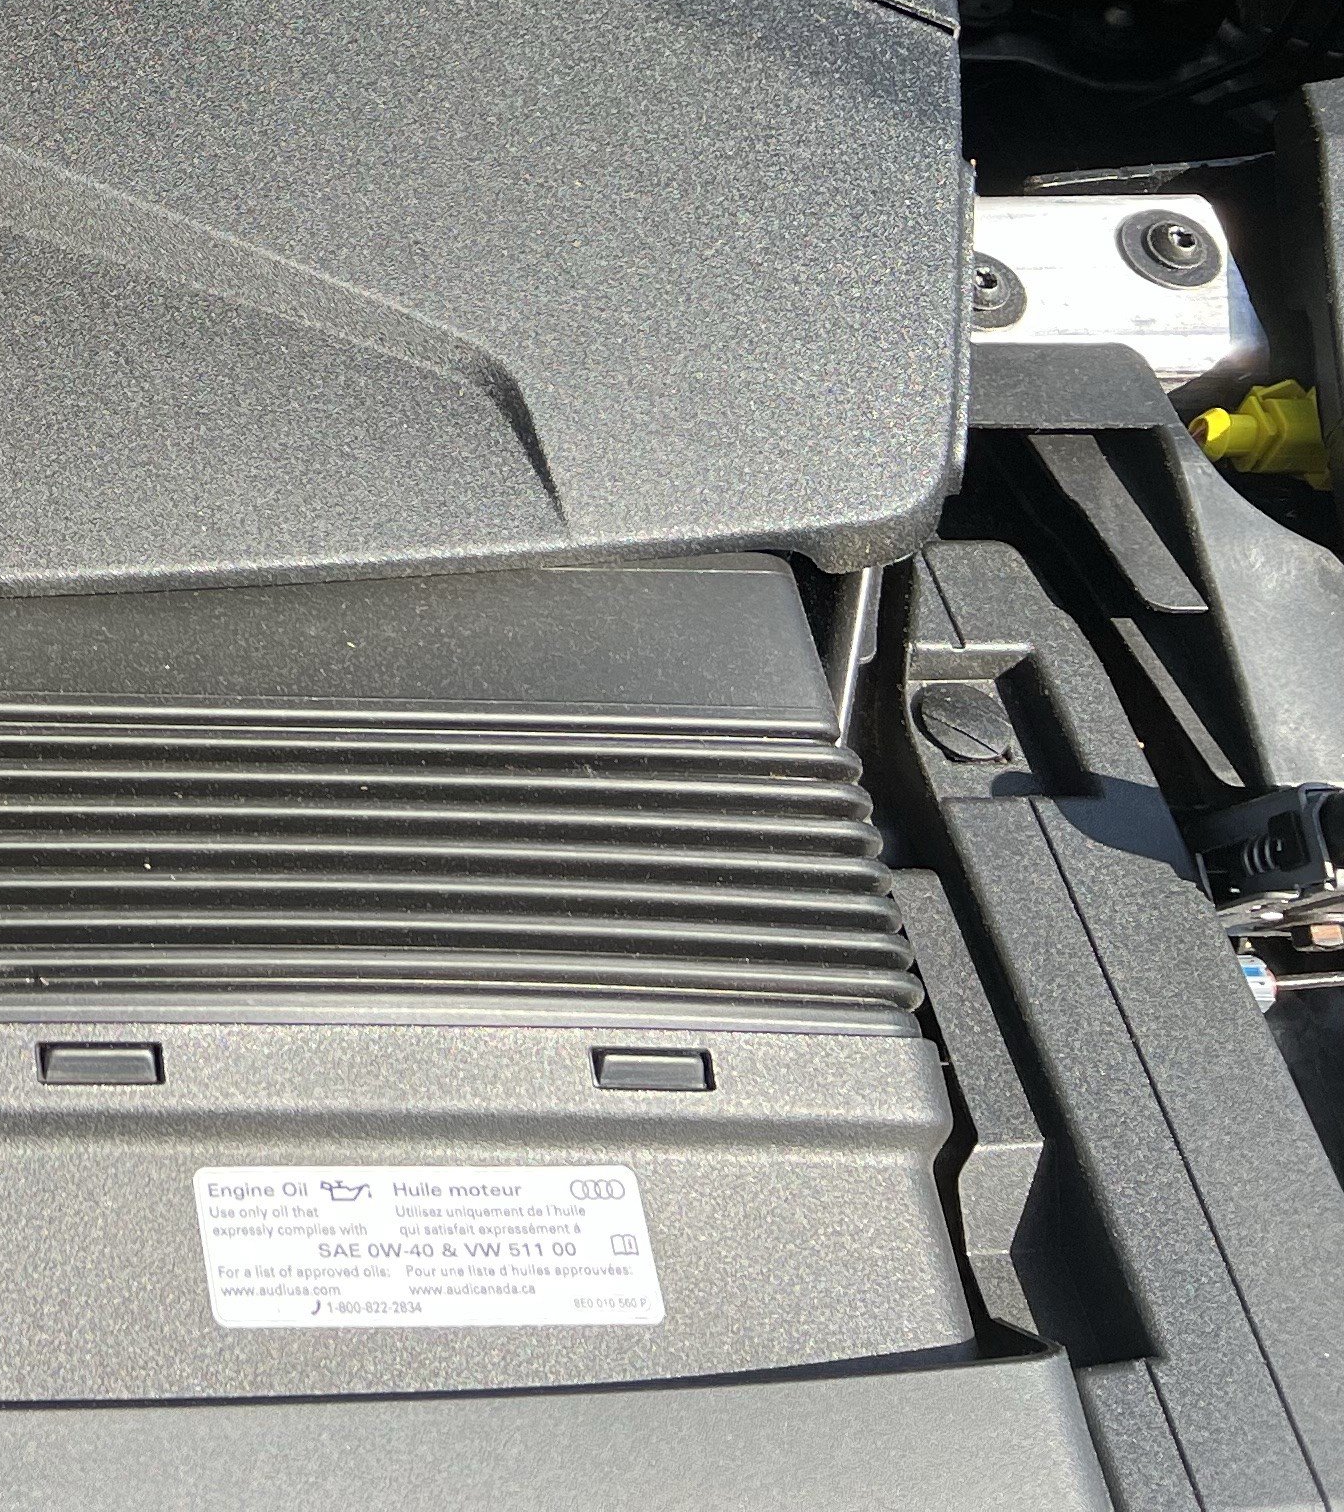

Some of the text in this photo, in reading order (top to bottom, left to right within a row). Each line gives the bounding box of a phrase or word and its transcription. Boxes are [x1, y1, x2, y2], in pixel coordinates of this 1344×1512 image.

[207, 1181, 308, 1200] Engine Oil
[392, 1181, 522, 1197] Huile moteur
[209, 1206, 319, 1221] Use only oil that
[395, 1205, 442, 1218] Utilisez
[446, 1205, 524, 1220] uniquement
[527, 1205, 543, 1217] de
[212, 1223, 368, 1238] expressly complies with
[399, 1223, 420, 1237] qui
[424, 1222, 475, 1235] satisfait
[479, 1222, 569, 1237] expressément
[318, 1242, 577, 1258] SAE 0W-40 & VW 511 00
[217, 1265, 240, 1278] For
[244, 1268, 252, 1278] a
[255, 1265, 275, 1278] list
[279, 1265, 294, 1278] of
[297, 1265, 360, 1280] approved
[406, 1265, 436, 1277] Pour
[440, 1266, 464, 1277] une
[468, 1264, 495, 1277] liste
[220, 1283, 341, 1297] www.audiusa.com
[408, 1282, 536, 1296] www.audicanada.ca
[327, 1301, 422, 1314] 1-800-822-2834
